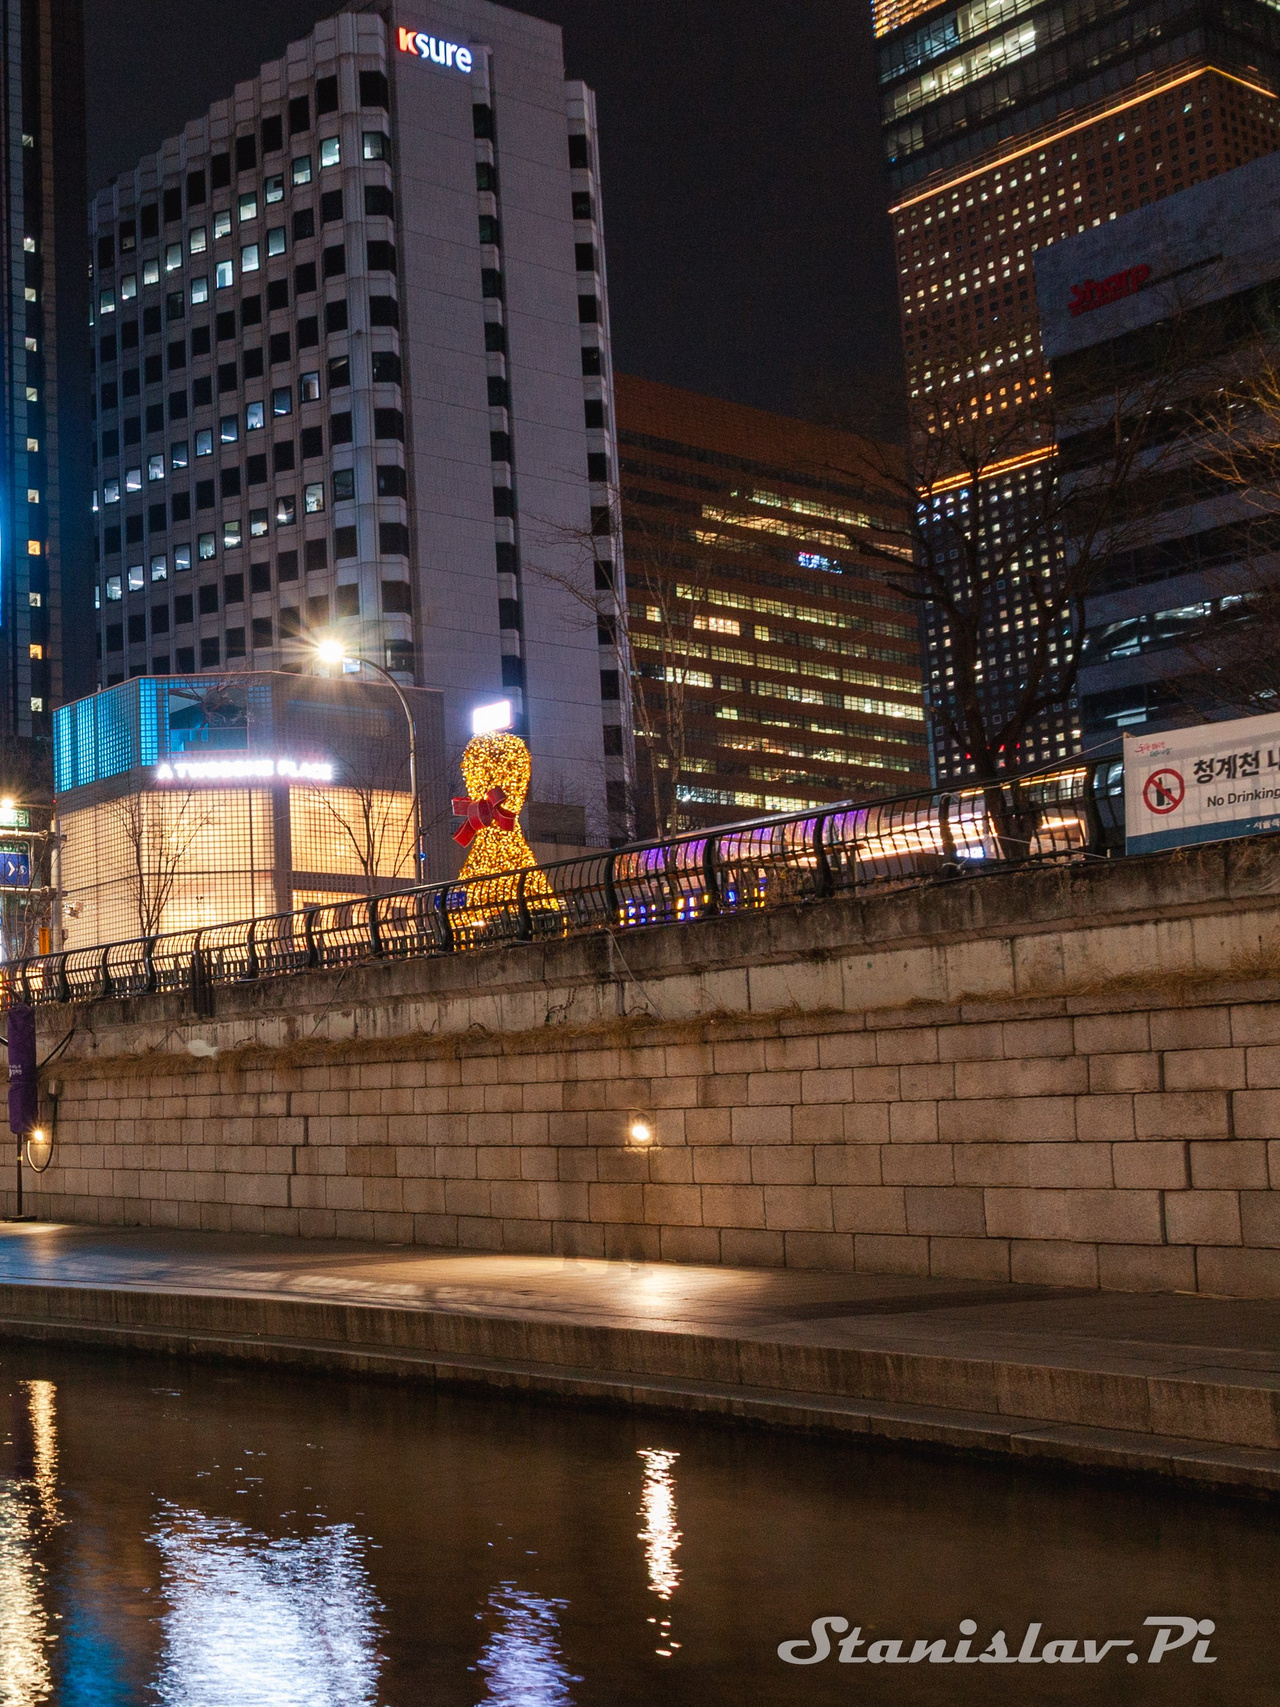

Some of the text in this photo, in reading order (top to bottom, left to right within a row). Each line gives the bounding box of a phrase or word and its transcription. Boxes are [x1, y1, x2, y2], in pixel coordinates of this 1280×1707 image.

[157, 763, 173, 779] A
[1193, 750, 1260, 785] 청계천
[1206, 786, 1280, 808] No Drinking
